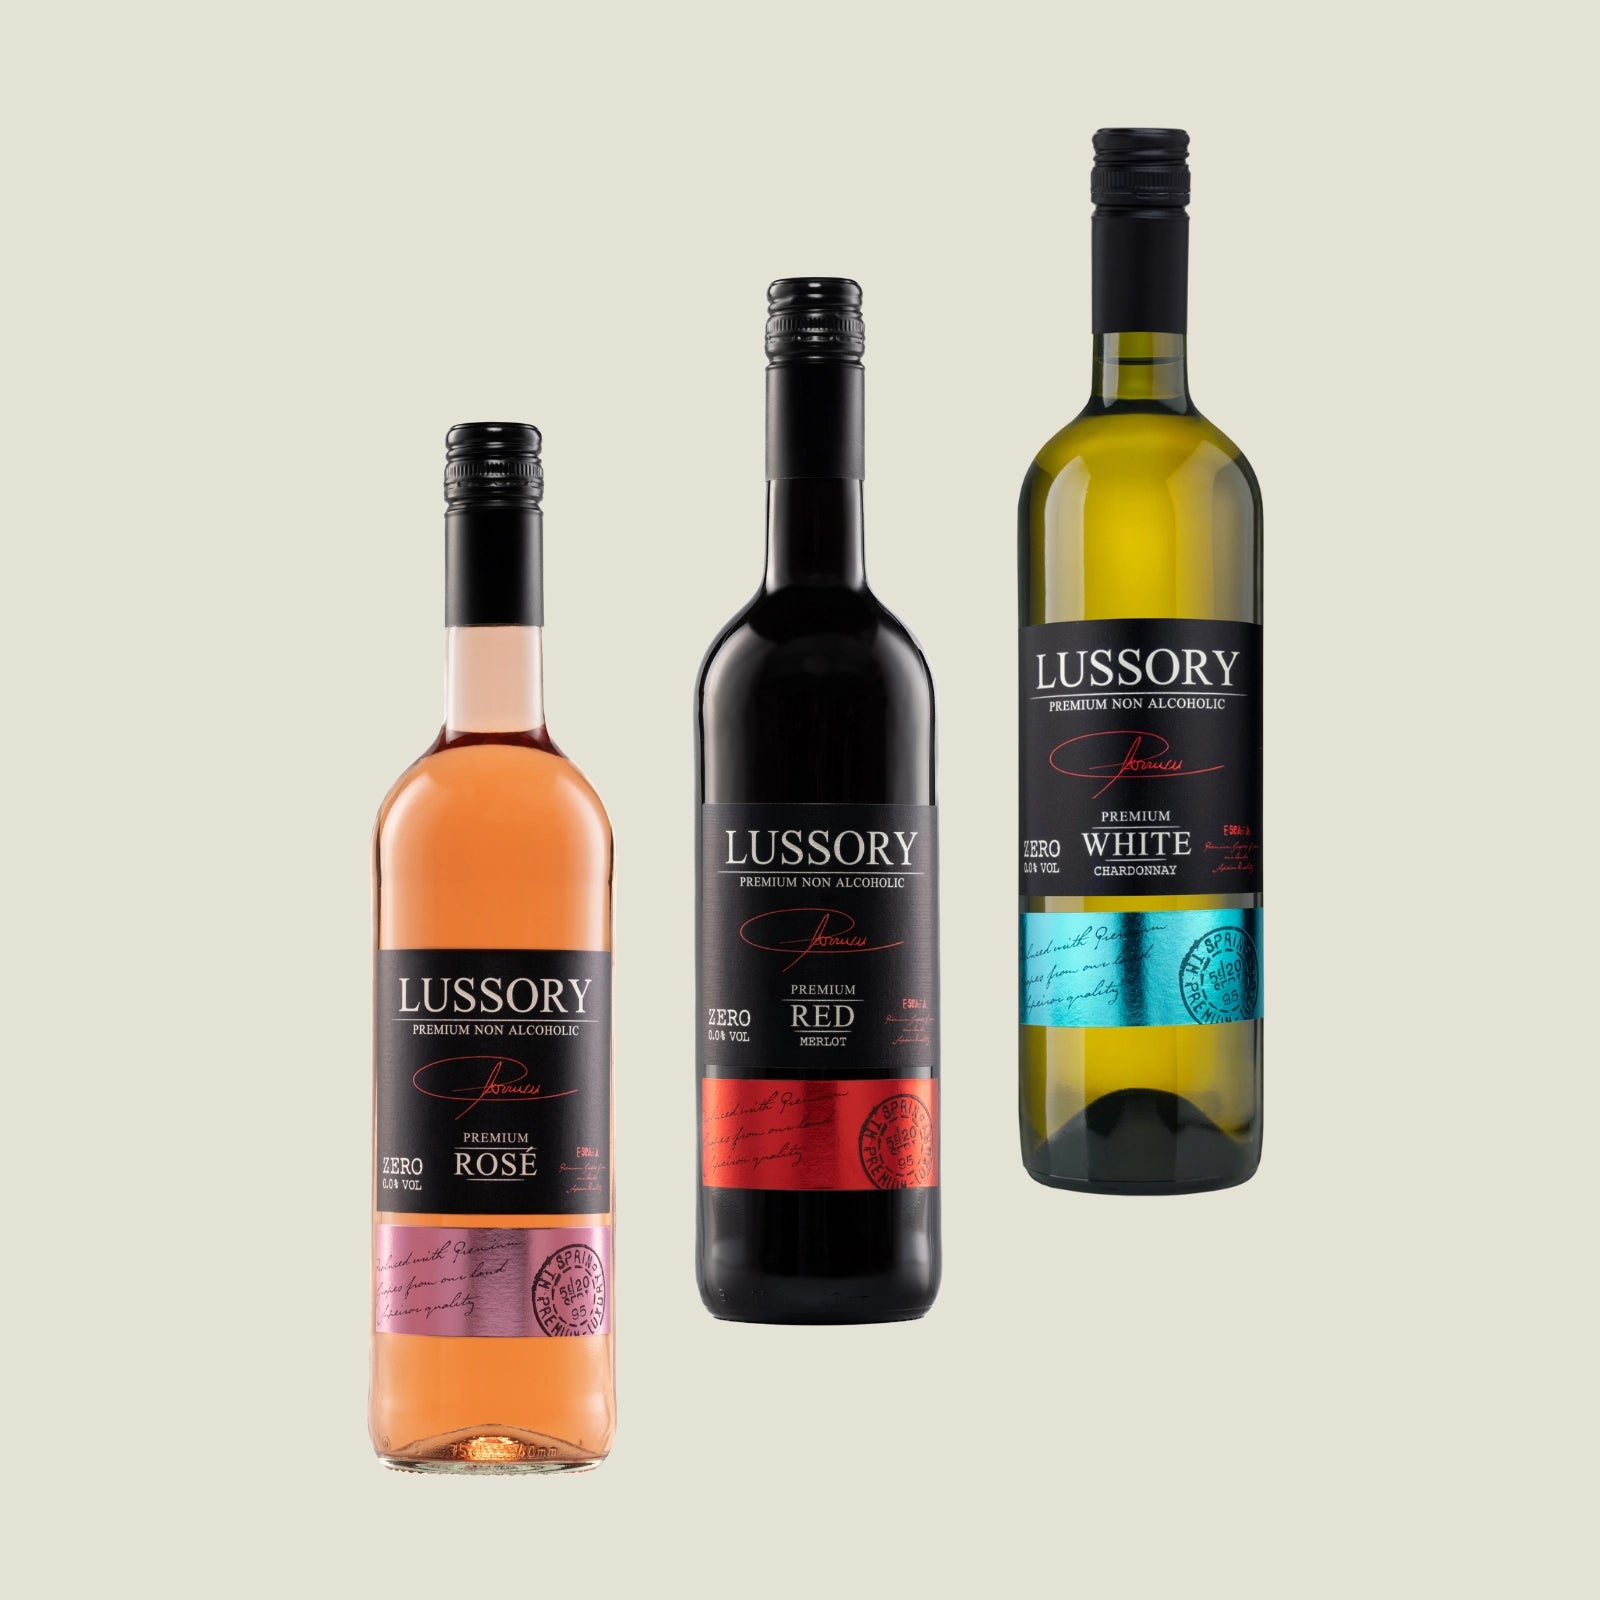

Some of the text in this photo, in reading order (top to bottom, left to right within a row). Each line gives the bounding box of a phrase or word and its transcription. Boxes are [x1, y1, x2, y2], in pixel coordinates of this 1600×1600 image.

[1036, 648, 1240, 690] LUSSORY
[1048, 698, 1226, 712] PREMIUM NON ALCOHOLIC
[1101, 810, 1170, 822] PREMIUM
[725, 830, 918, 866] LUSSORY
[1023, 840, 1060, 858] ZERO
[1081, 831, 1192, 857] WHITE
[1040, 862, 1060, 874] VOL
[1094, 865, 1177, 876] CHARDONNAY
[740, 876, 905, 888] PREMIUM NON ALCOHOLIC
[1046, 964, 1078, 989] from
[399, 977, 592, 1013] LUSSORY
[791, 984, 856, 995] PREMIUM
[1066, 980, 1124, 1010] quality
[708, 1008, 751, 1027] ZERO
[790, 1004, 854, 1028] RED
[412, 1024, 579, 1036] PREMIUM NON ALCOHOLIC
[708, 1031, 750, 1042] 0.0% VOL
[800, 1037, 847, 1047] MERLOT
[463, 1132, 528, 1143] PREMIUM
[731, 1127, 764, 1150] from
[453, 1146, 538, 1177] ROSÉ
[752, 1142, 806, 1170] quality
[382, 1157, 423, 1176] ZERO
[382, 1179, 422, 1191] 0.0% VOL
[404, 1276, 437, 1300] from
[424, 1292, 480, 1320] quality
